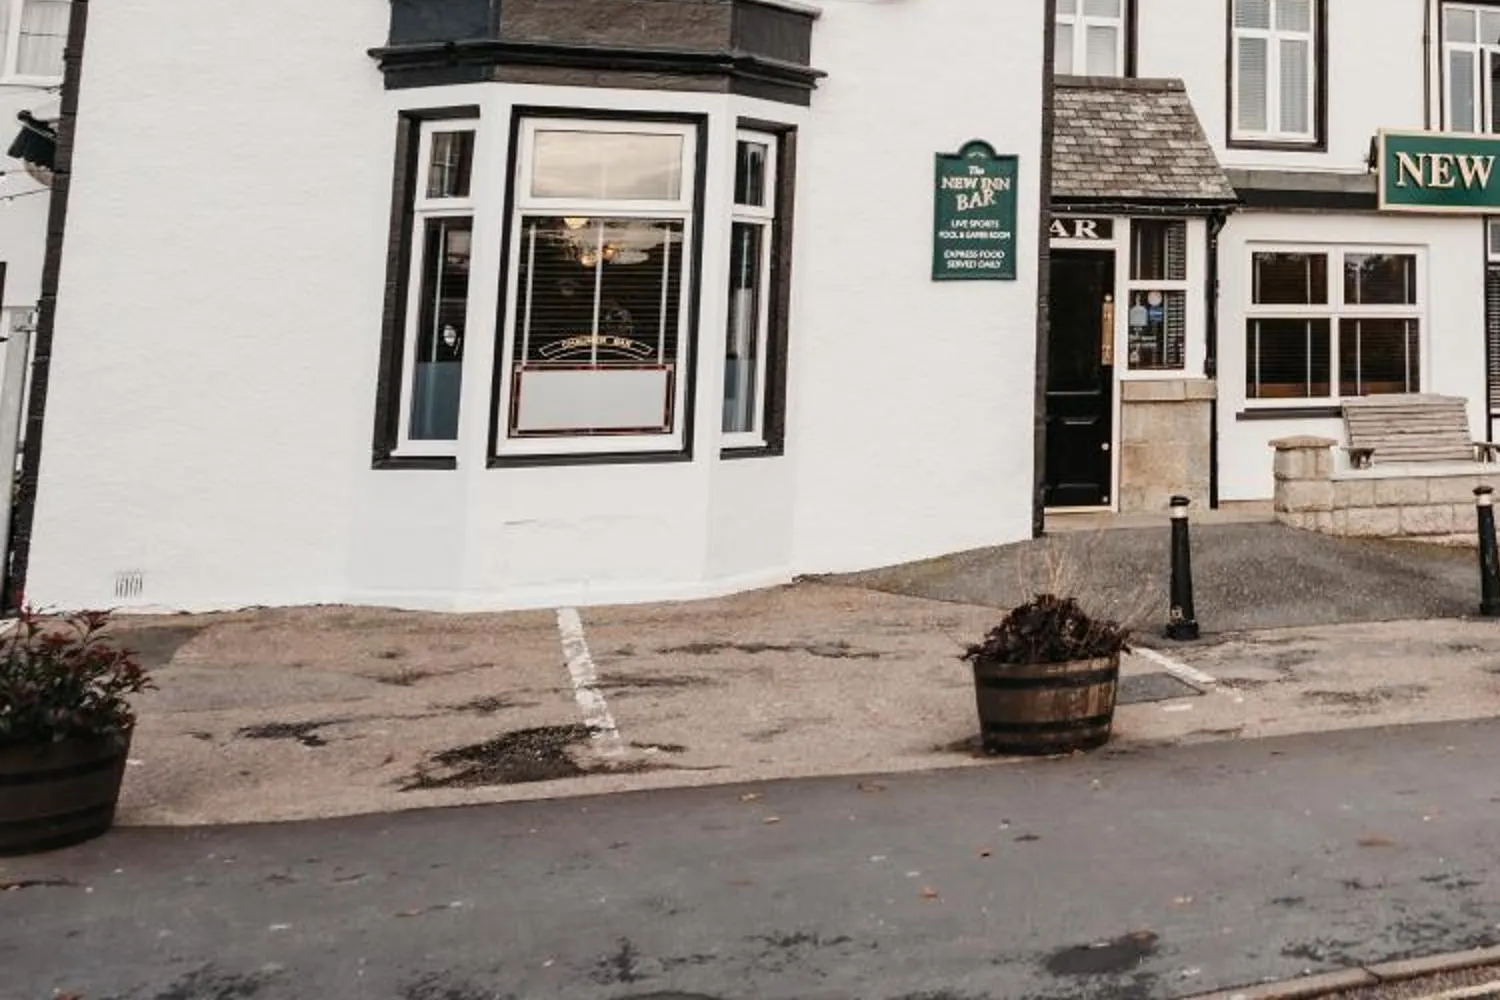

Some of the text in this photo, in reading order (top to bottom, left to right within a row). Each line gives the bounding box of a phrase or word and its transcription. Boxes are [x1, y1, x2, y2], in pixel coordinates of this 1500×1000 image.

[967, 165, 985, 175] The
[1395, 151, 1496, 190] NEW
[941, 176, 1011, 191] NEW INN
[956, 189, 998, 212] BAR
